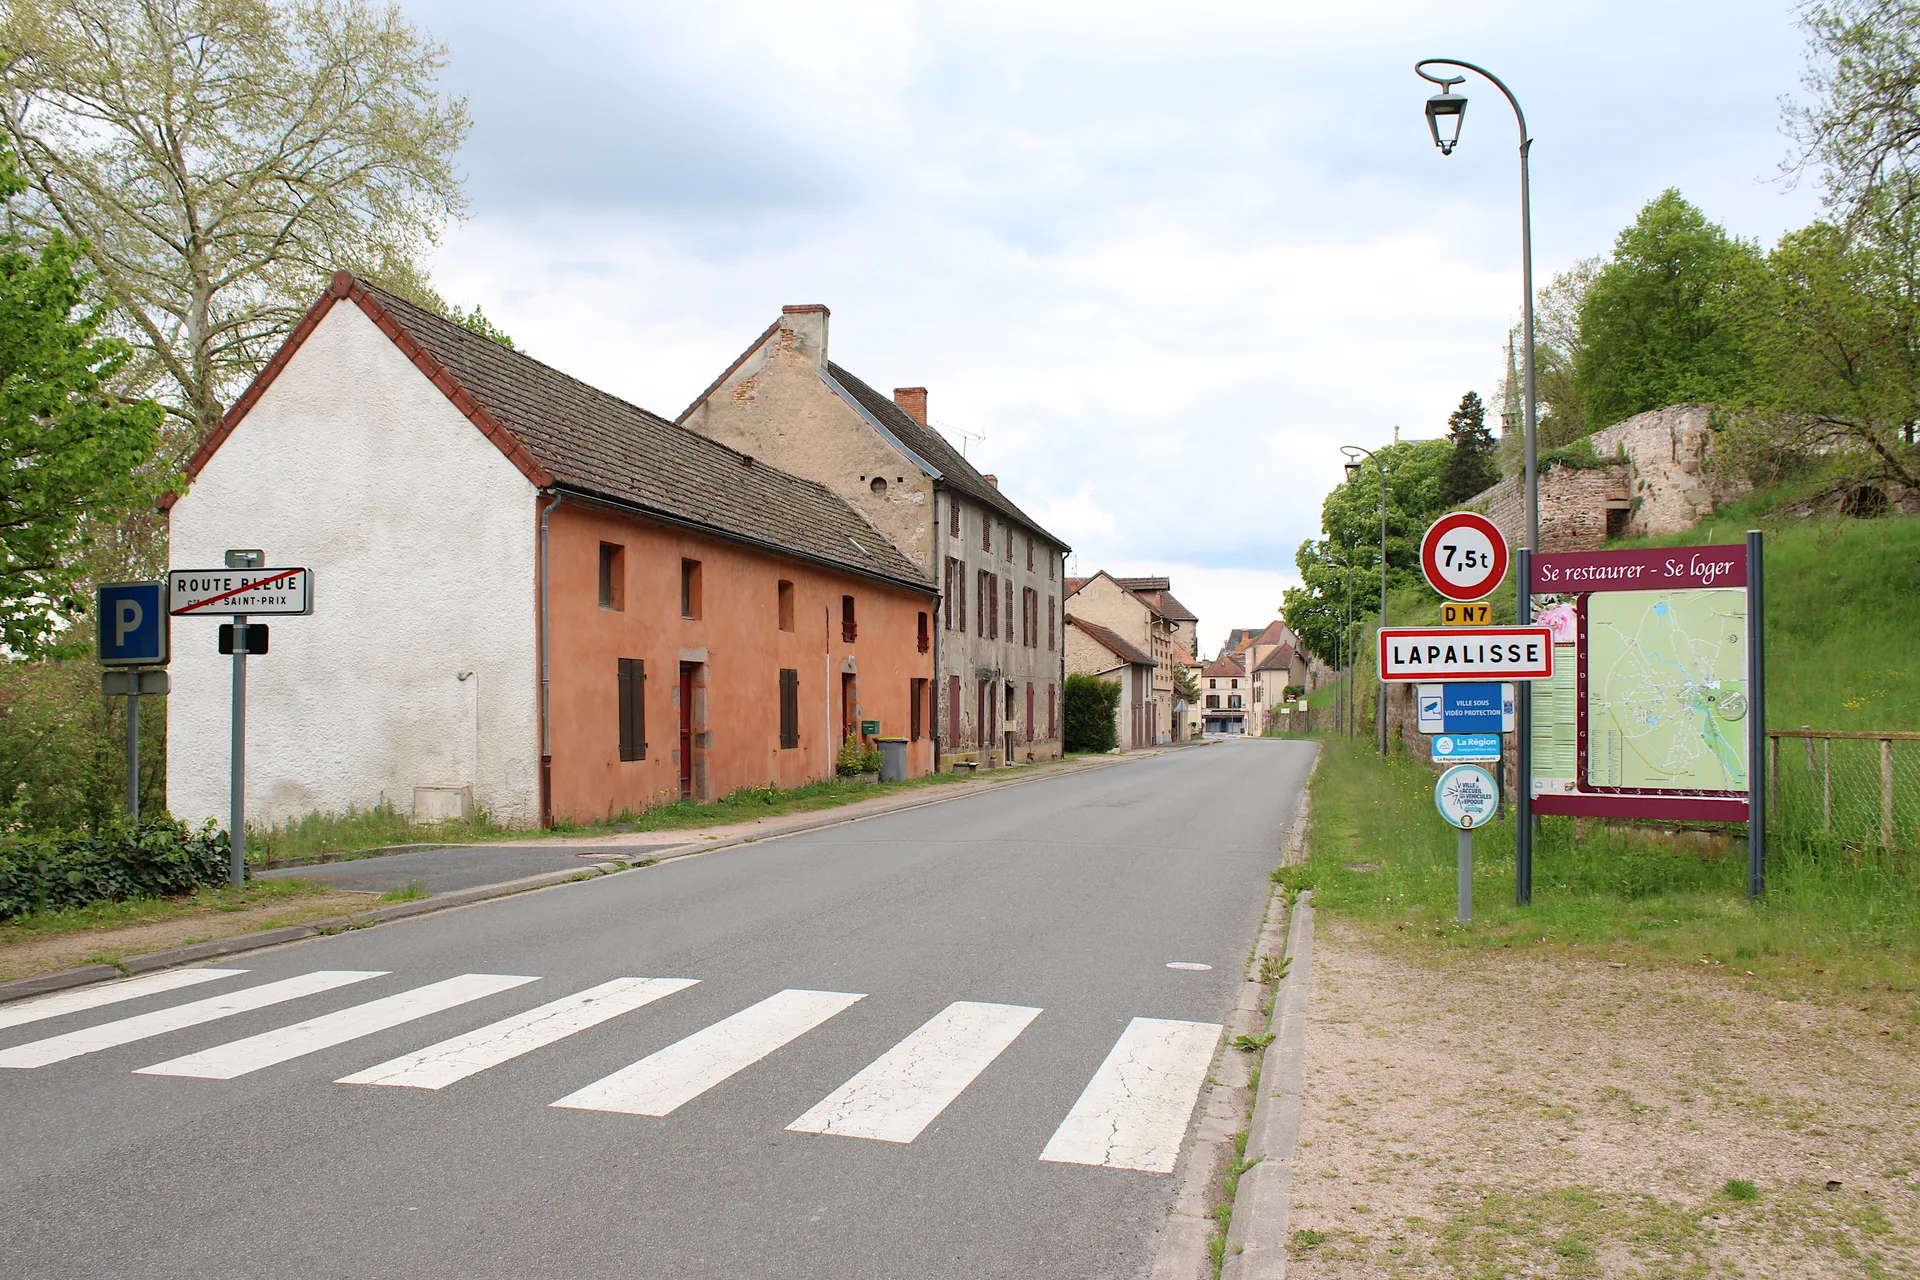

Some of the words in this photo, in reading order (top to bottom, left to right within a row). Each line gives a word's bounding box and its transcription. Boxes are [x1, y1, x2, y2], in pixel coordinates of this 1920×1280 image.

[1540, 563, 1560, 582] Se
[1564, 563, 1645, 581] restaurer
[1663, 558, 1684, 578] Se
[1689, 553, 1735, 585] loger
[178, 578, 232, 592] ROUTE
[241, 577, 297, 591] BLEUE
[224, 596, 287, 606] SAINT-PRIX
[115, 599, 143, 647] P
[1394, 644, 1539, 665] LAPALISSE
[1468, 738, 1496, 747] Région
